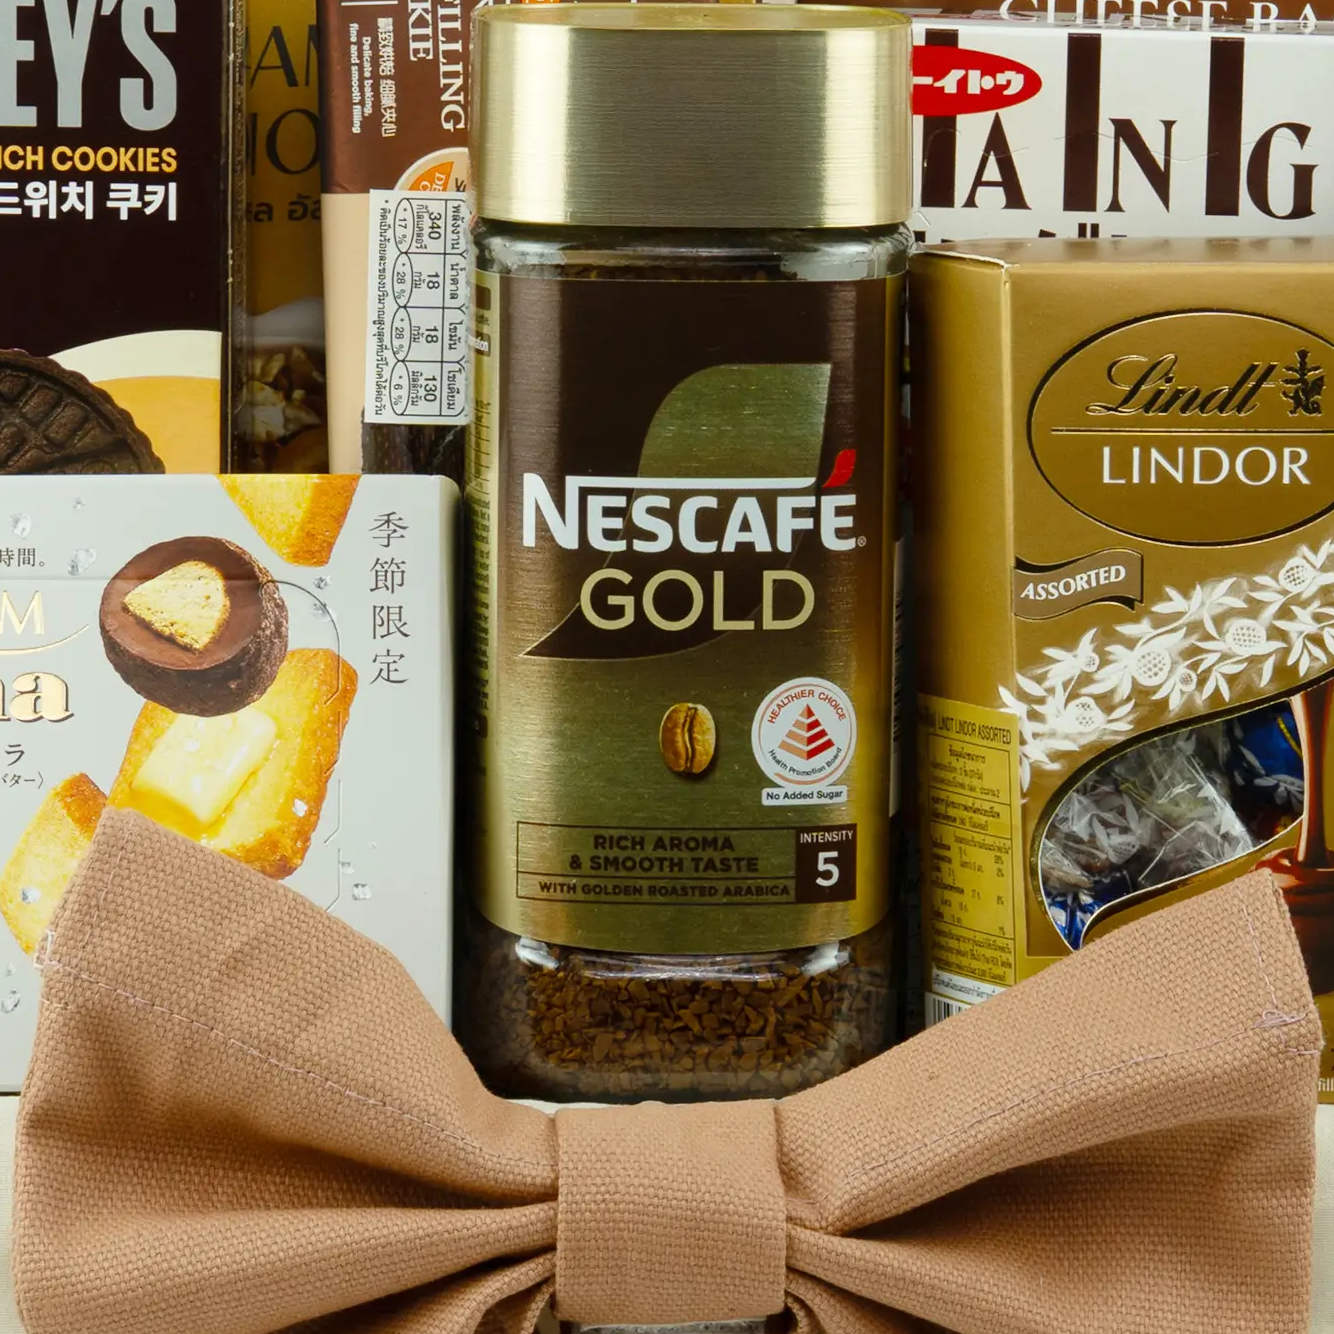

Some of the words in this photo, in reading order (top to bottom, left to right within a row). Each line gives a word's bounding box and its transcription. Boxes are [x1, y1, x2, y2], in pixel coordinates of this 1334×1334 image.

[350, 22, 359, 41] fine
[351, 44, 360, 63] and
[362, 36, 371, 77] Delicate
[352, 65, 360, 102] smooth
[913, 68, 1025, 96] ーイトウ
[352, 103, 362, 134] filling
[51, 146, 177, 173] COOKIES
[106, 181, 177, 221] 쿠키
[399, 217, 407, 230] 17
[428, 212, 443, 240] 340
[450, 203, 468, 251] พลังงาน
[396, 271, 405, 285] 28
[427, 272, 440, 289] 18
[395, 326, 404, 340] 28
[425, 325, 438, 344] 18
[424, 375, 438, 402] 130
[1085, 352, 1281, 417] Lindt
[1102, 446, 1311, 486] LINDOR
[1021, 564, 1127, 602] ASSORTED
[368, 511, 411, 685] 季節限定
[580, 568, 815, 631] GOLD
[768, 689, 815, 724] HEALTHIER
[818, 691, 847, 722] CHOICE
[978, 724, 1012, 745] ASSORTED
[768, 748, 788, 771] Health
[788, 764, 826, 777] Promotion
[825, 746, 842, 768] Board
[766, 791, 781, 801] No
[783, 790, 815, 800] Added
[816, 789, 844, 801] Sugar
[593, 834, 646, 852] RICH
[652, 836, 735, 853] AROMA
[800, 830, 853, 843] INTENSITY
[569, 854, 583, 870] &
[590, 855, 685, 873] SMOOTH
[690, 856, 760, 873] TASTE
[815, 851, 840, 887] 5
[538, 881, 577, 894] WITH
[581, 883, 643, 897] GOLDEN
[648, 884, 718, 898] ROASTED
[723, 884, 790, 898] ARABICA
